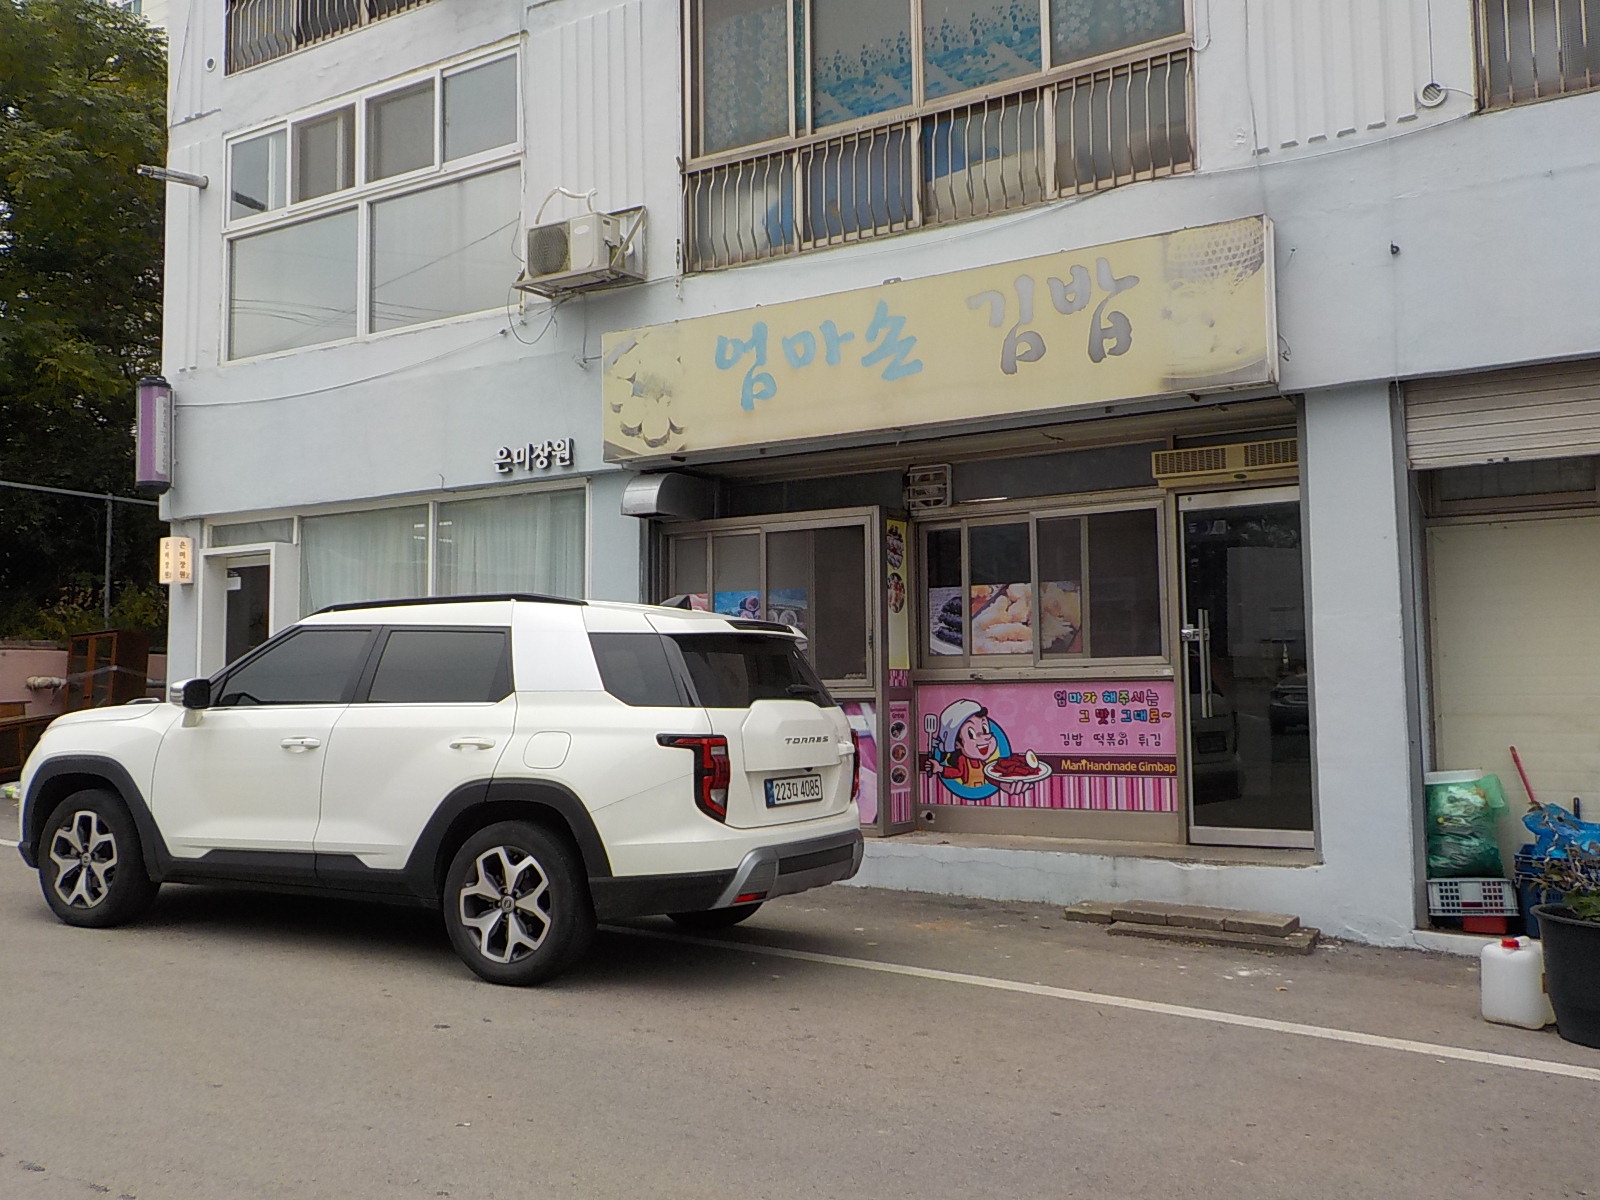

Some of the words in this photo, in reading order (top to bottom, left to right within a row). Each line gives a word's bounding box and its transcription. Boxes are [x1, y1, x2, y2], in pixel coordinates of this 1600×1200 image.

[715, 300, 923, 411] 엄마손
[966, 257, 1140, 375] 김밥
[492, 437, 574, 473] 은미장원
[1054, 690, 1097, 707] 엄마가
[1101, 689, 1159, 707] 해주시는
[1079, 709, 1090, 722] 그
[1095, 708, 1115, 725] 맛!
[785, 736, 829, 745] TORRES
[1060, 733, 1083, 746] 김밥
[1093, 732, 1128, 746] 떡볶이
[1138, 733, 1161, 746] 튀김
[1087, 761, 1138, 772] Handmade
[1138, 761, 1176, 773] Gimbap
[775, 782, 798, 801] 223다
[801, 779, 820, 798] 4085
